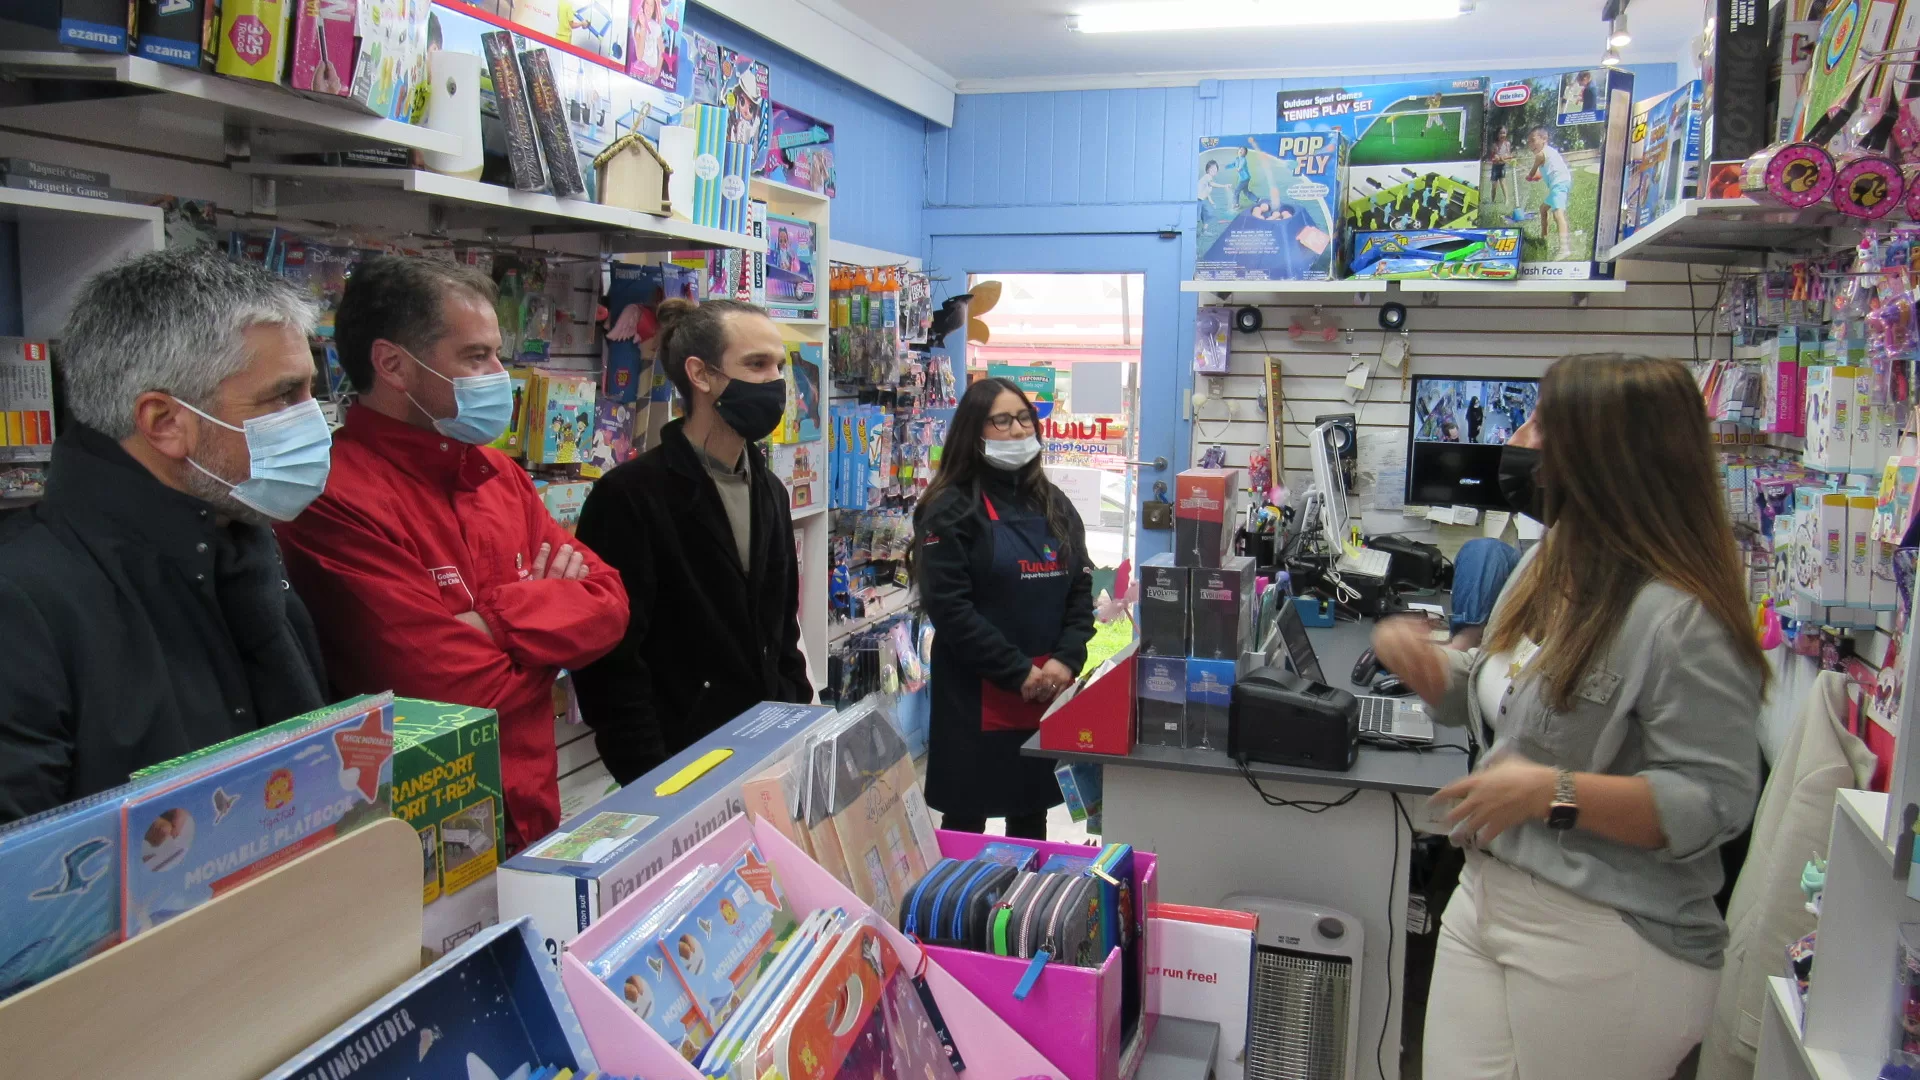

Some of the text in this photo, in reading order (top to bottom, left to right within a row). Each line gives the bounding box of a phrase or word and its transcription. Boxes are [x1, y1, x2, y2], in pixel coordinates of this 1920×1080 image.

[68, 27, 118, 45] ezama
[237, 22, 247, 53] TRUCOS
[248, 23, 264, 56] 325
[145, 44, 192, 60] ezama
[1283, 91, 1363, 109] Outdoor Sport Games
[1283, 100, 1373, 122] TENNIS PLAY SET
[1279, 136, 1323, 157] POP
[29, 162, 96, 182] Magnetic Games
[1294, 155, 1330, 175] FLY
[28, 179, 109, 199] Magnetic Games
[1495, 238, 1518, 252] 45
[1542, 266, 1563, 276] Face
[393, 752, 475, 804] RANSPORT
[393, 772, 477, 821] ORT T-REX
[184, 834, 270, 891] MOVABLE
[1162, 969, 1184, 979] run
[1186, 967, 1218, 985] free!
